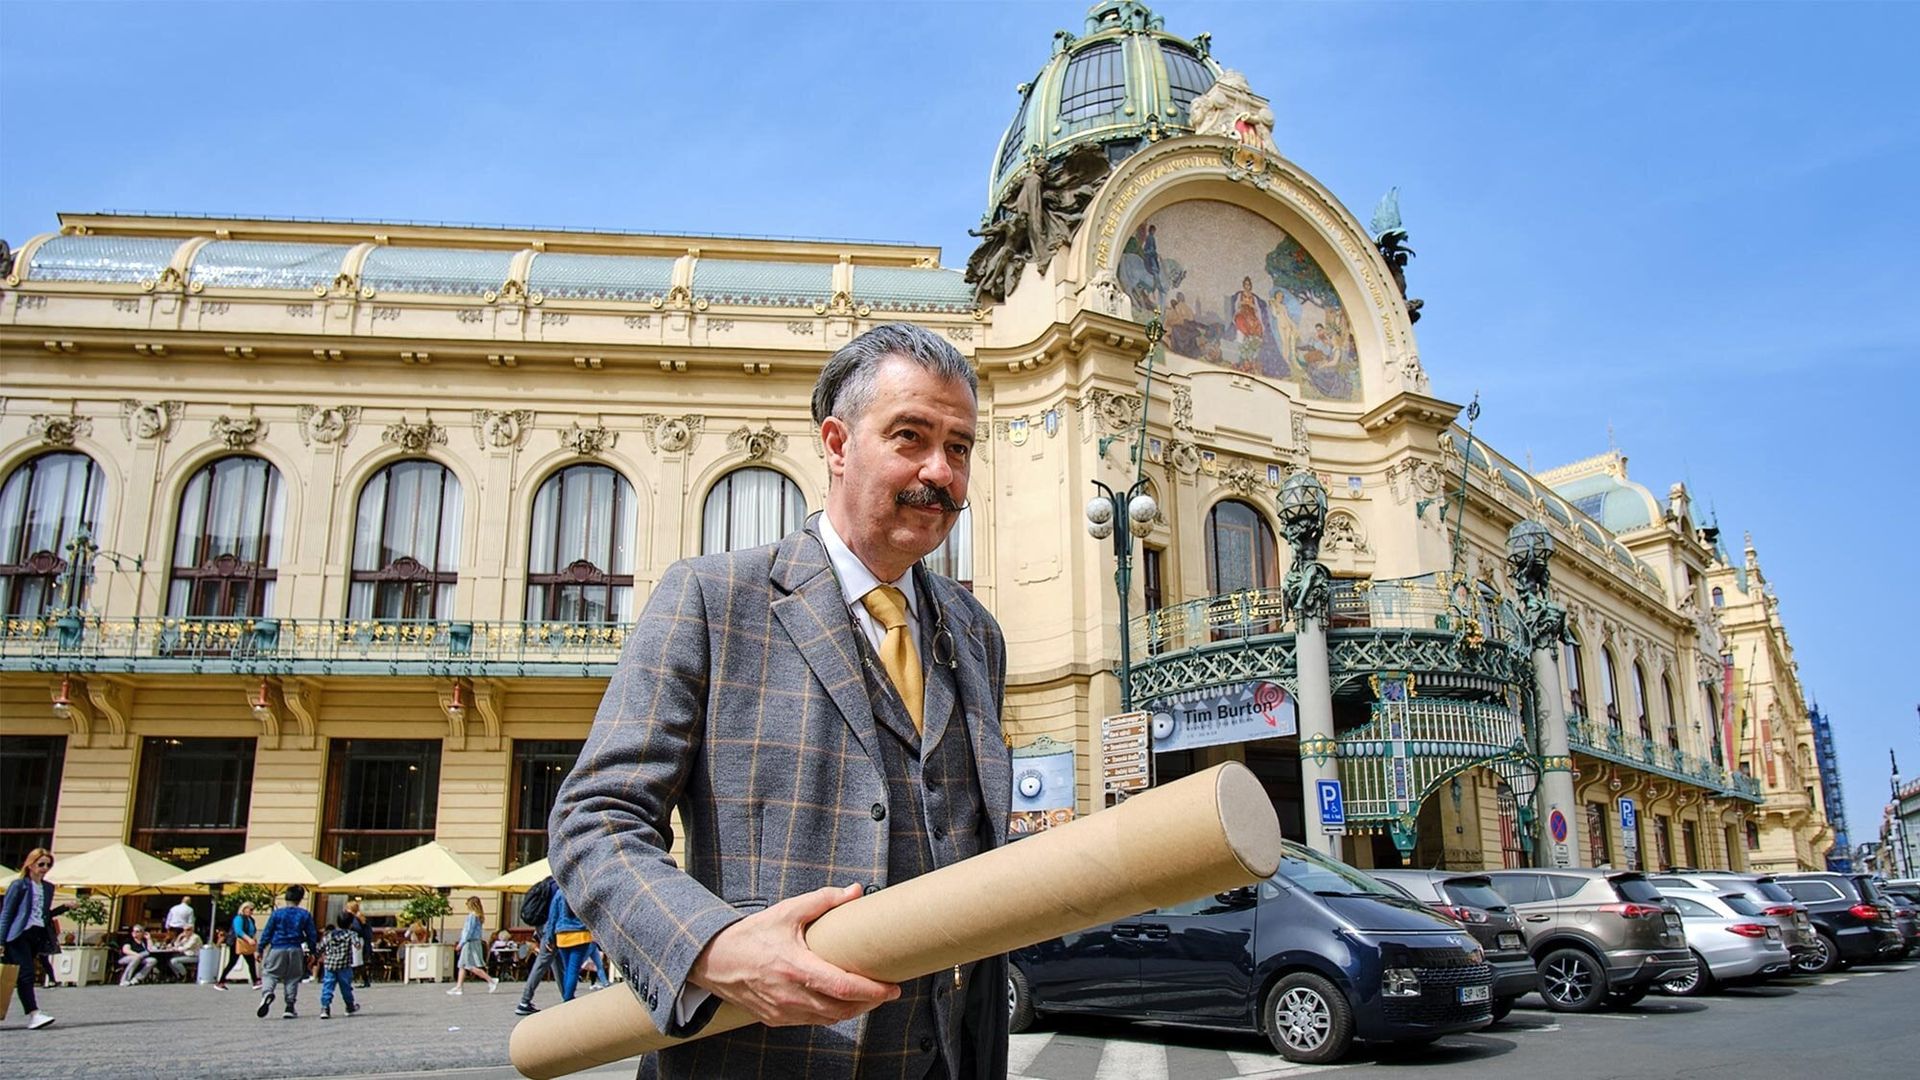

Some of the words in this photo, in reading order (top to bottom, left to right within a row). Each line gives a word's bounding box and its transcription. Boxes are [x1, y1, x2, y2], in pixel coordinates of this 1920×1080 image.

[1183, 709, 1212, 724] Tim
[1217, 701, 1273, 719] Burton
[1322, 785, 1337, 810] P
[1622, 802, 1631, 819] P
